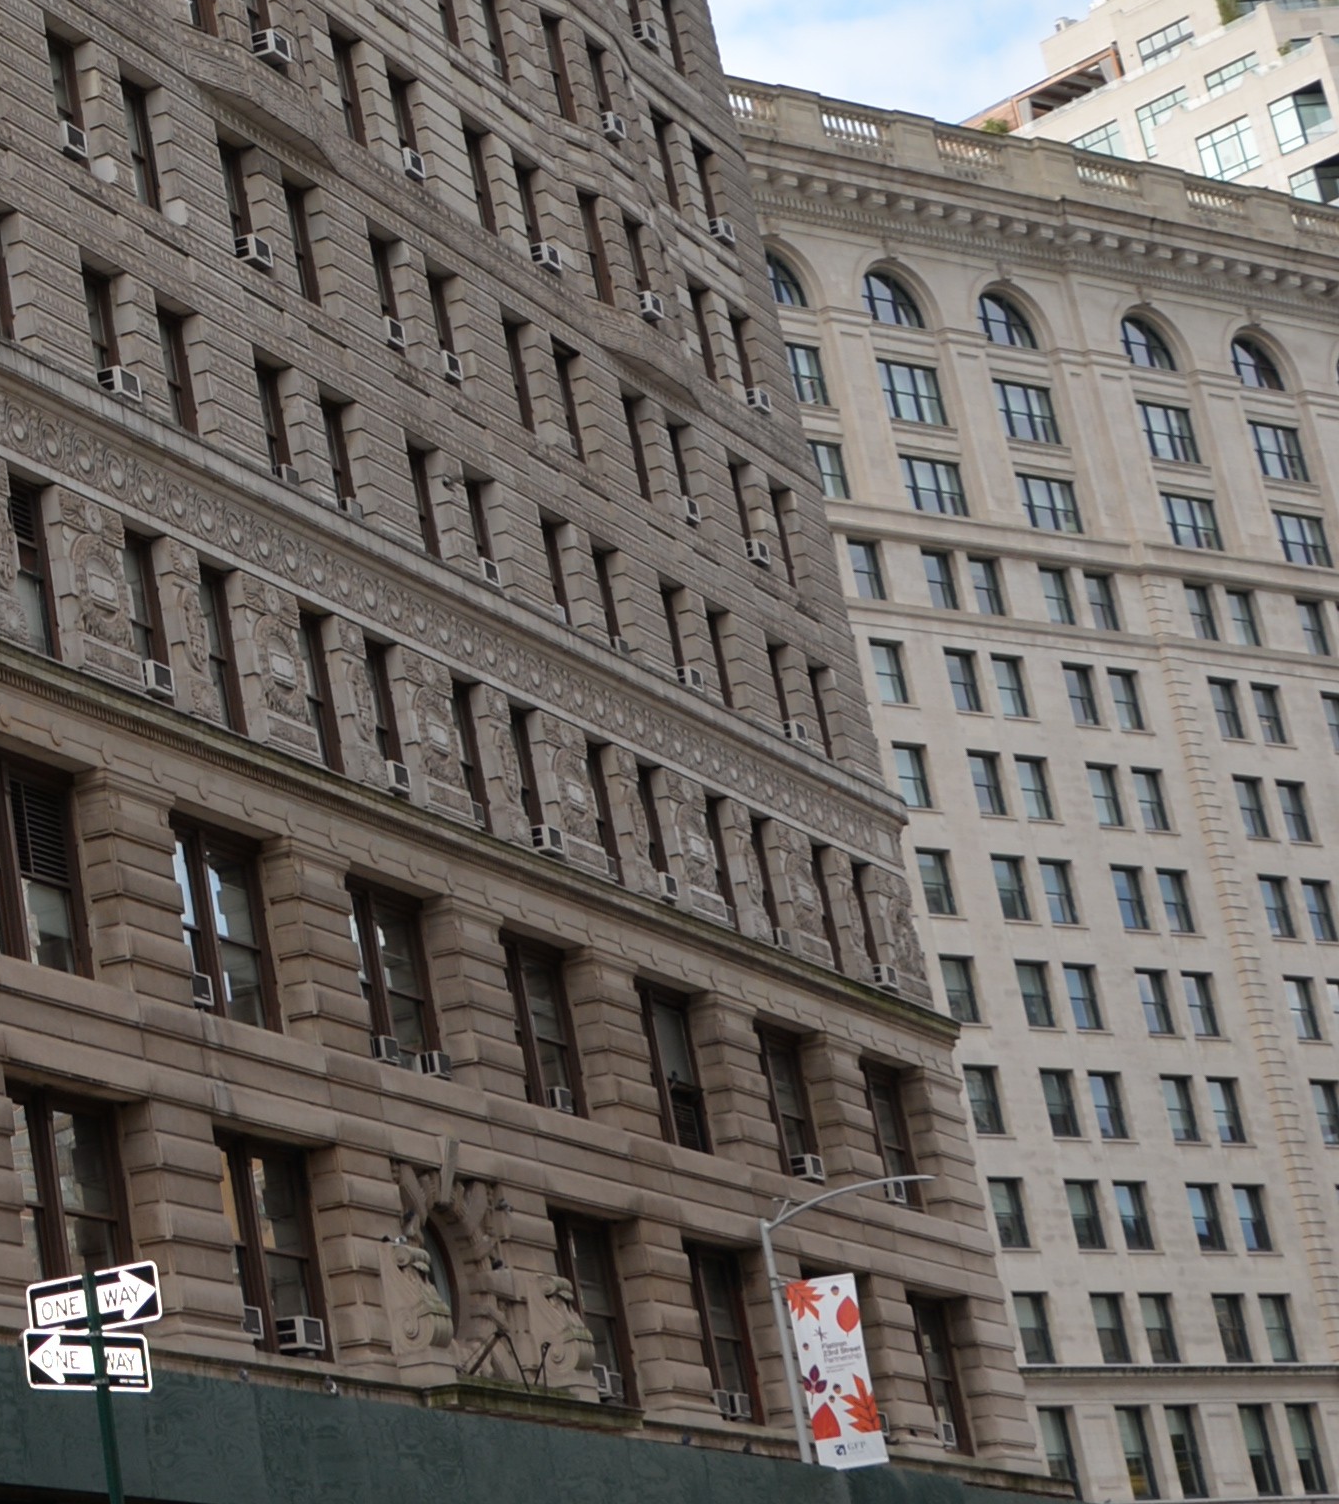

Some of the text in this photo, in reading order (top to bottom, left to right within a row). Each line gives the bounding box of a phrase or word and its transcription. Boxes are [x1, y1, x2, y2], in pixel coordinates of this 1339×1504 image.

[41, 1283, 141, 1321] ONE WAY
[41, 1350, 81, 1370] ONE
